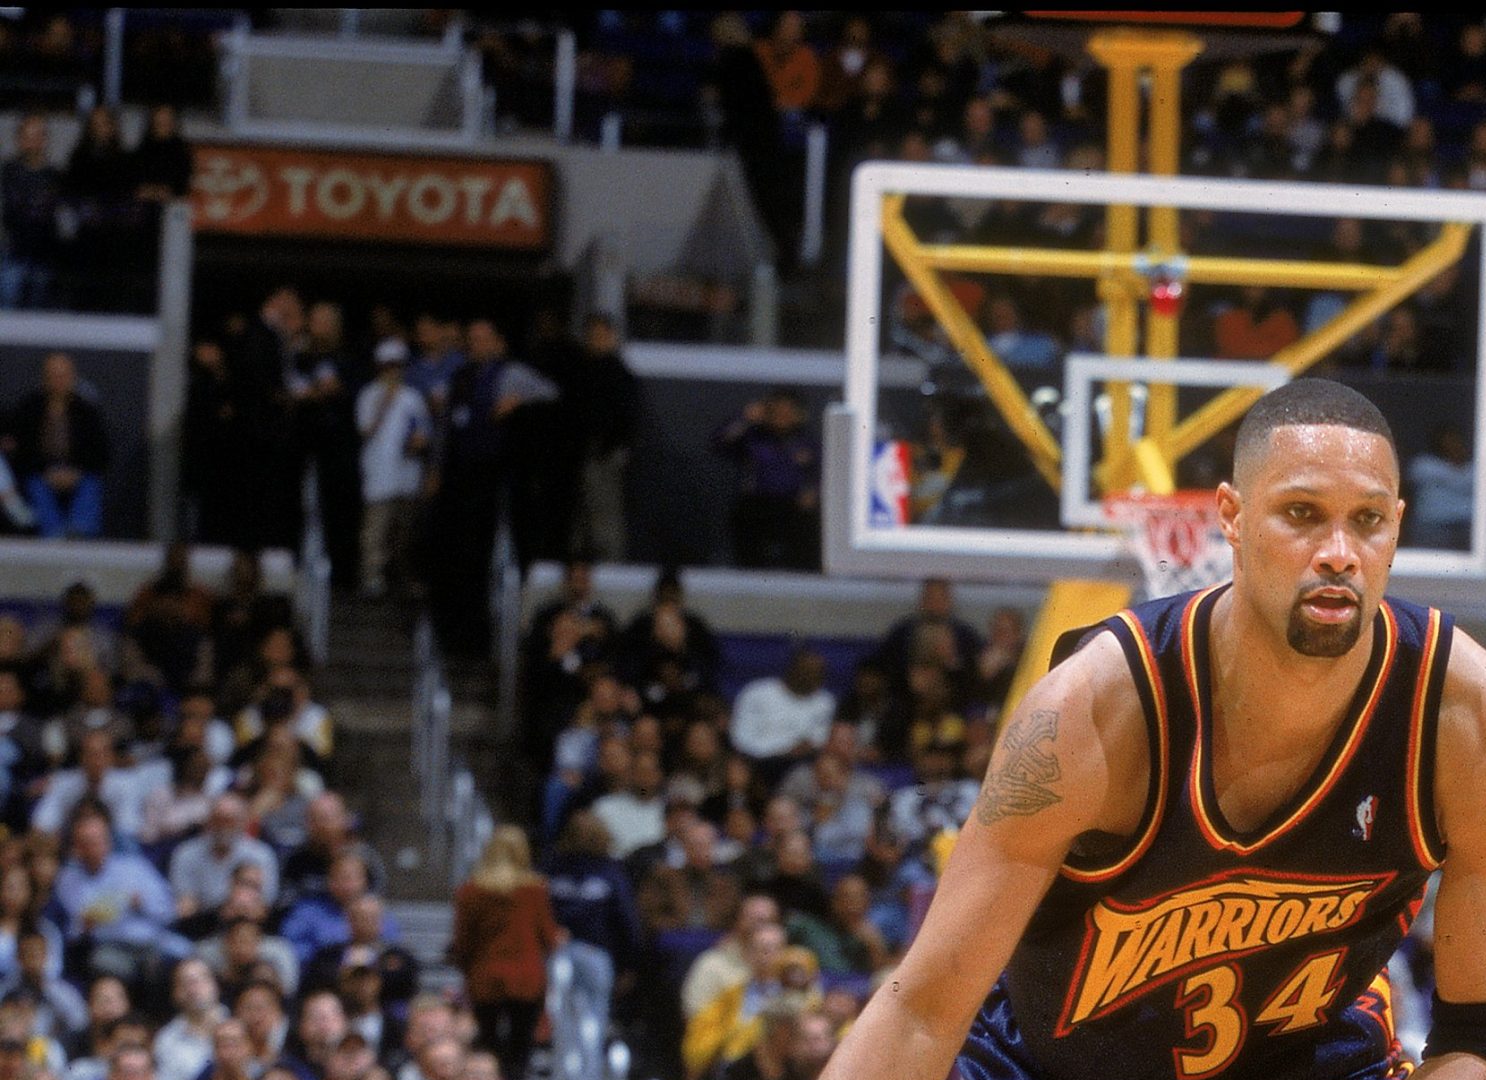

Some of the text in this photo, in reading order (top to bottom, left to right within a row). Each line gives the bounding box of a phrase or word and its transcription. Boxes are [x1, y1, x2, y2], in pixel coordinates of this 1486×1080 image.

[281, 166, 538, 226] TOYOTA
[1060, 874, 1385, 1032] WARRIORS
[1173, 950, 1346, 1080] 34
